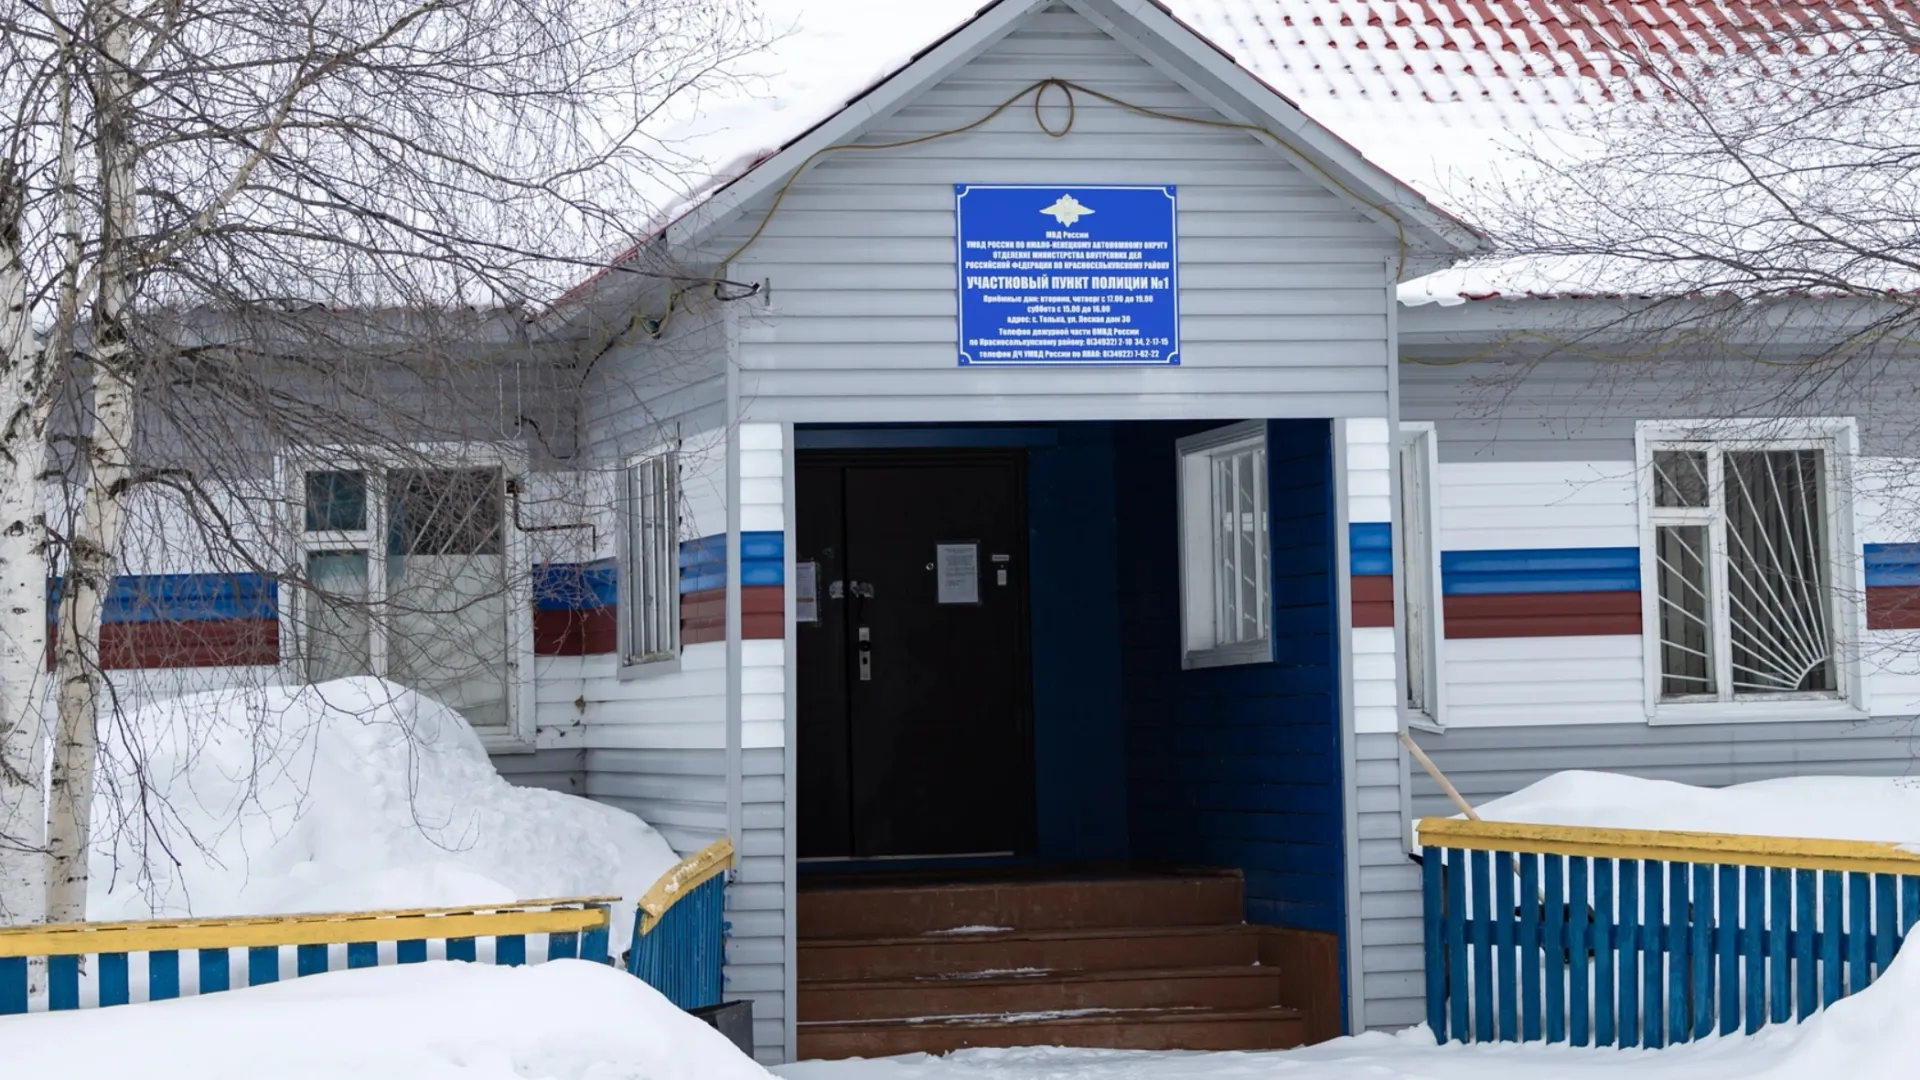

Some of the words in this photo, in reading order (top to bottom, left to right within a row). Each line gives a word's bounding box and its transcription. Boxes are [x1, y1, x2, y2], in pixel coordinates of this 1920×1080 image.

[1046, 231, 1062, 239] МВД
[1063, 231, 1089, 239] России
[966, 241, 987, 249] УМВД
[987, 241, 1015, 249] РОССИИ
[1015, 241, 1025, 249] ПО
[1026, 241, 1092, 249] ЯМАЛО-НЕНЕЦКОМУ
[1092, 241, 1143, 249] АВТОНОМНОМУ
[1144, 241, 1168, 249] ОКРУГУ
[993, 251, 1031, 259] ОТДЕЛЕНИЕ
[1032, 251, 1085, 259] МИНИСТЕРСТВА
[1086, 251, 1128, 259] ВНУТРЕННИХ
[1128, 251, 1142, 260] ДЕЛ
[965, 260, 1011, 269] РОССИЙСКОЙ
[1011, 261, 1053, 269] ФЕДЕРАЦИИ
[1053, 261, 1063, 269] ПО
[1144, 260, 1170, 269] РАЙОНУ
[966, 274, 1049, 289] УЧАСТКОВЫЙ
[1051, 276, 1089, 289] ПУНКТ
[1091, 276, 1148, 291] ПОЛИЦИИ
[1150, 276, 1169, 289] №1
[1027, 305, 1056, 313] суббота
[1063, 305, 1081, 313] 15.00
[1007, 316, 1031, 324] адрес:
[1067, 316, 1078, 324] ул.
[1078, 315, 1105, 323] Лесная
[1105, 316, 1121, 324] дом
[999, 328, 1031, 336] Телефон
[1032, 327, 1069, 336] дежурной
[1070, 328, 1092, 336] части
[1113, 328, 1140, 336] России
[969, 338, 979, 346] по
[979, 350, 1012, 358] телефон
[1012, 350, 1023, 358] ДЧ
[1023, 350, 1044, 358] УМВД
[1044, 350, 1071, 358] России
